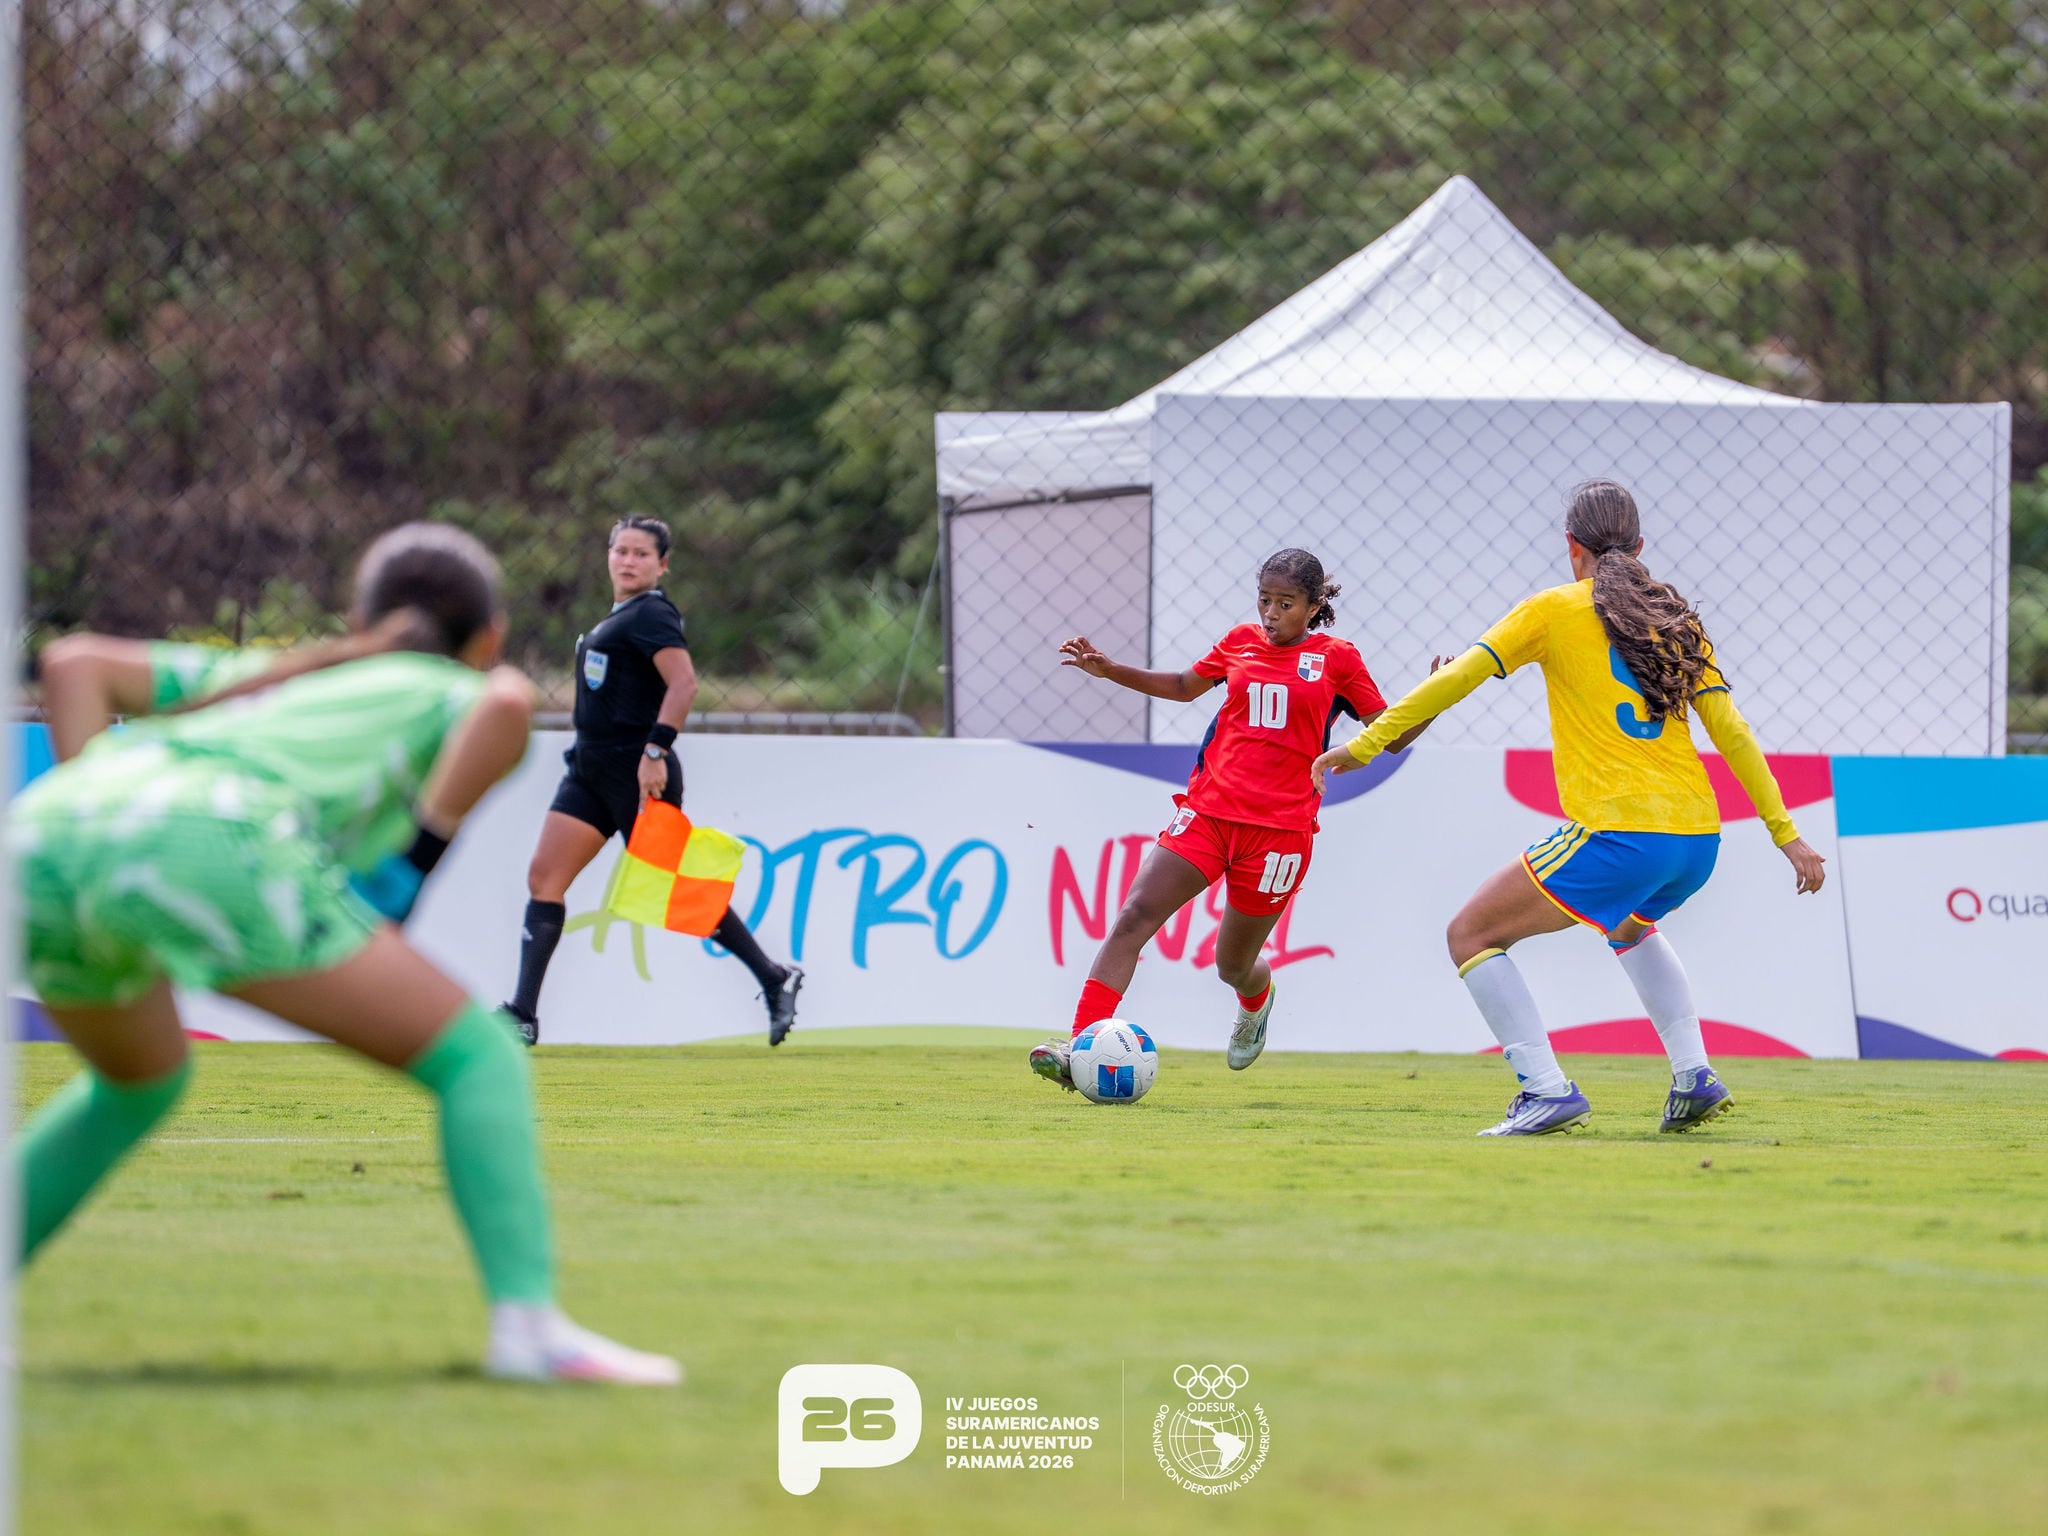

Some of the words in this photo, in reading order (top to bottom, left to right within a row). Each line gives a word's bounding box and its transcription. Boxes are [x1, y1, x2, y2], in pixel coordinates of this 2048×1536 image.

[1246, 682, 1288, 730] 10
[1258, 851, 1302, 895] 10
[1115, 1031, 1131, 1052] molten
